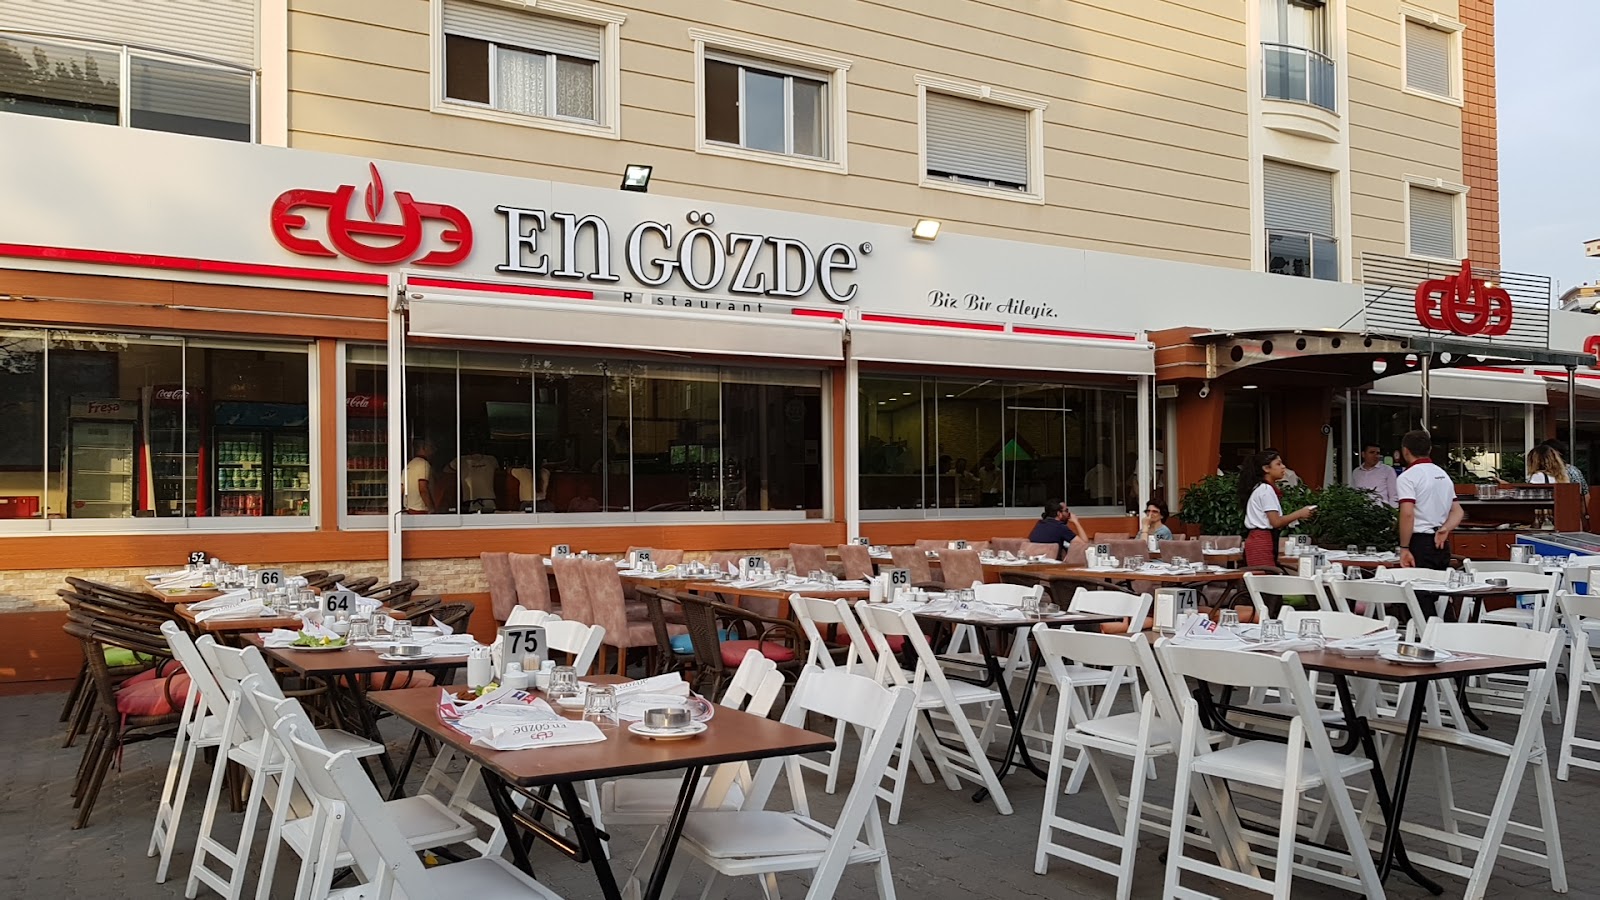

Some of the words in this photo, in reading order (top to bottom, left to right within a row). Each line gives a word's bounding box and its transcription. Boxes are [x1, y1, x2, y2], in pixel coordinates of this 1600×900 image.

[623, 292, 763, 313] Rstaurant
[927, 289, 958, 309] Biz
[963, 293, 991, 312] Bir
[1298, 535, 1307, 544] 69
[557, 546, 567, 554] 53
[1097, 544, 1107, 554] 68
[1525, 545, 1533, 555] 70
[191, 552, 205, 562] 52
[748, 556, 761, 568] 67
[261, 571, 279, 585] 66
[892, 571, 907, 584] 65
[327, 595, 349, 612] 64
[1178, 590, 1194, 609] 74
[508, 630, 538, 654] 75
